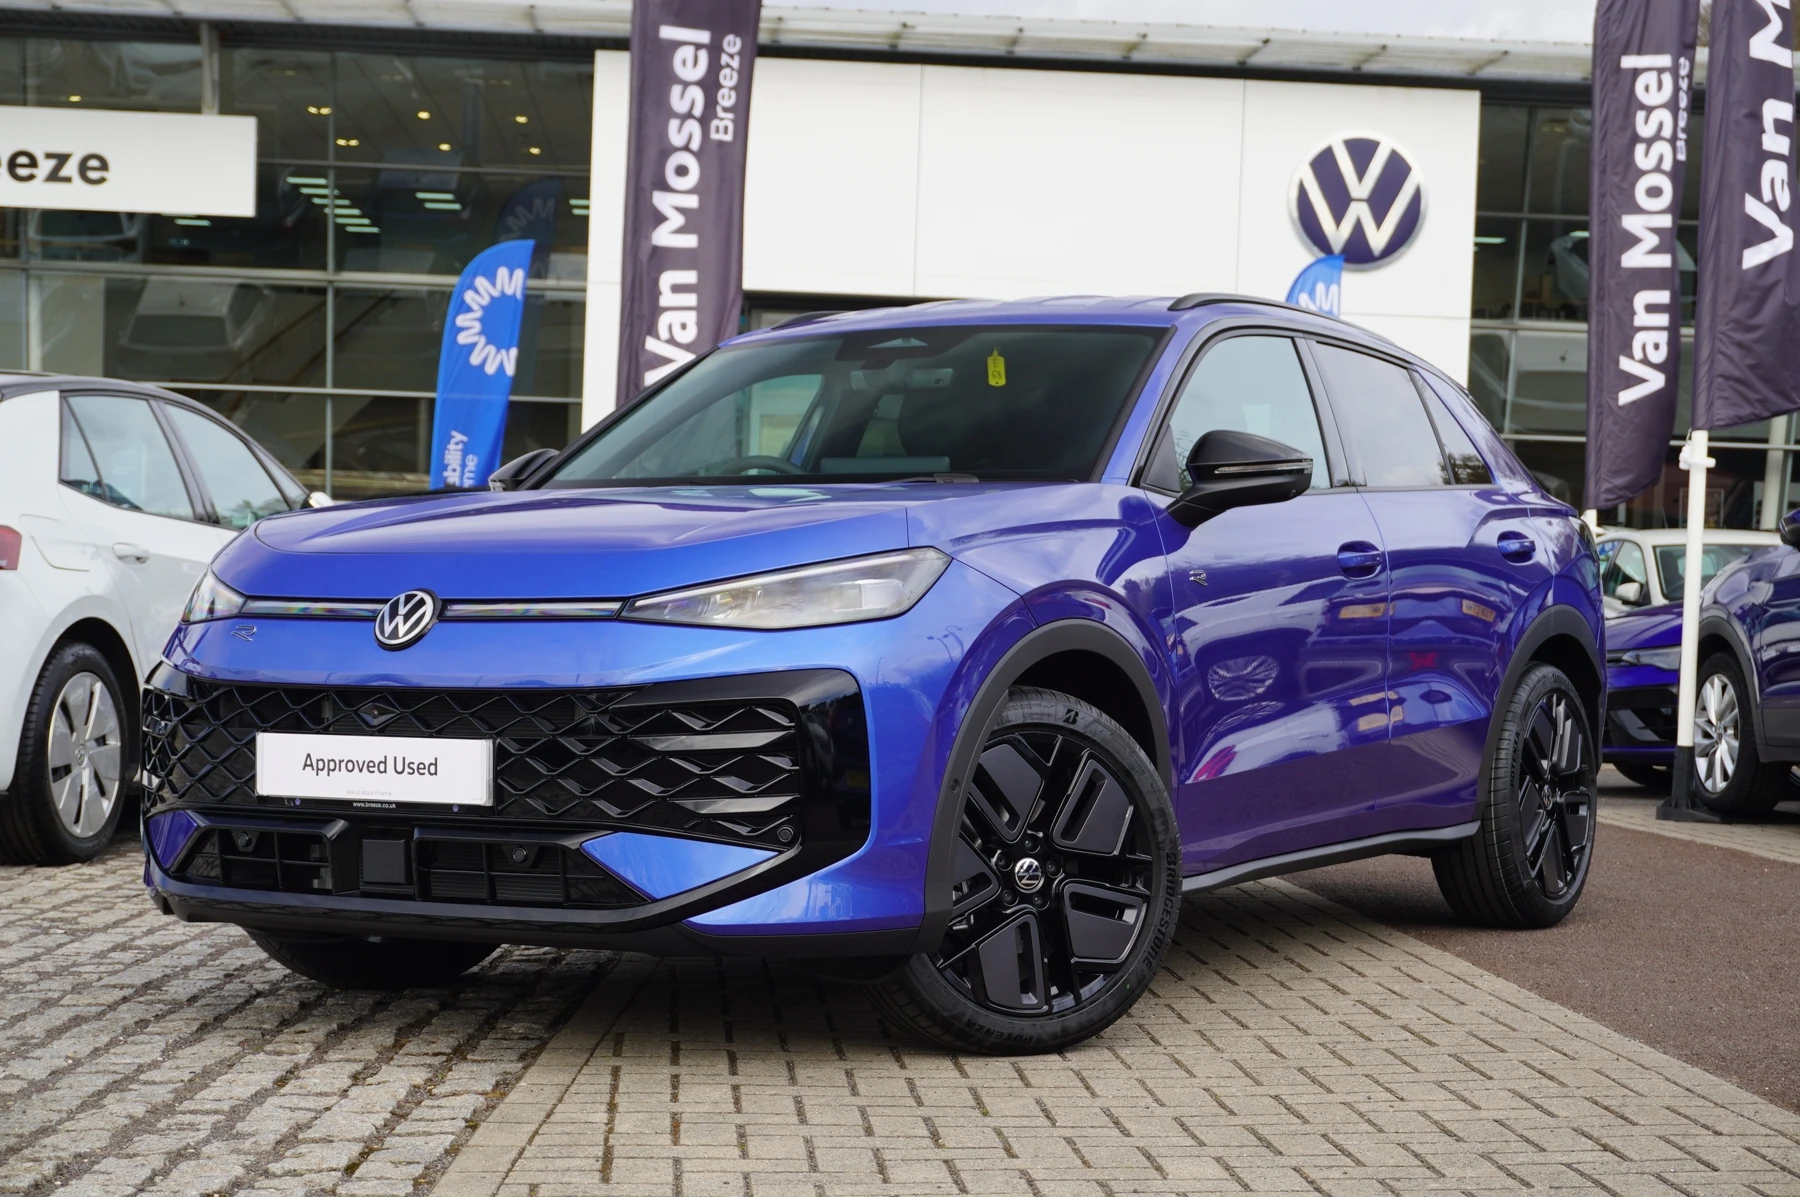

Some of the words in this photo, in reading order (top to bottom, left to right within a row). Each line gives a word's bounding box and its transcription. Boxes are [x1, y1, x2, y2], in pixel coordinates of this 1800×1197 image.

[651, 24, 711, 249] Mossel
[710, 33, 742, 142] Breeze
[1675, 56, 1690, 162] Breeze
[0, 149, 110, 186] eze
[1619, 53, 1674, 269] Mossel
[1742, 98, 1794, 271] Van
[643, 269, 699, 387] Van
[1617, 289, 1671, 407] Van
[302, 752, 388, 777] Approved
[393, 756, 438, 777] Used
[352, 801, 396, 809] www.breeze.co.uk
[1510, 731, 1520, 787] POTENZA
[1142, 851, 1177, 970] BRIDGESTONE
[966, 1018, 1034, 1043] POTENZA
